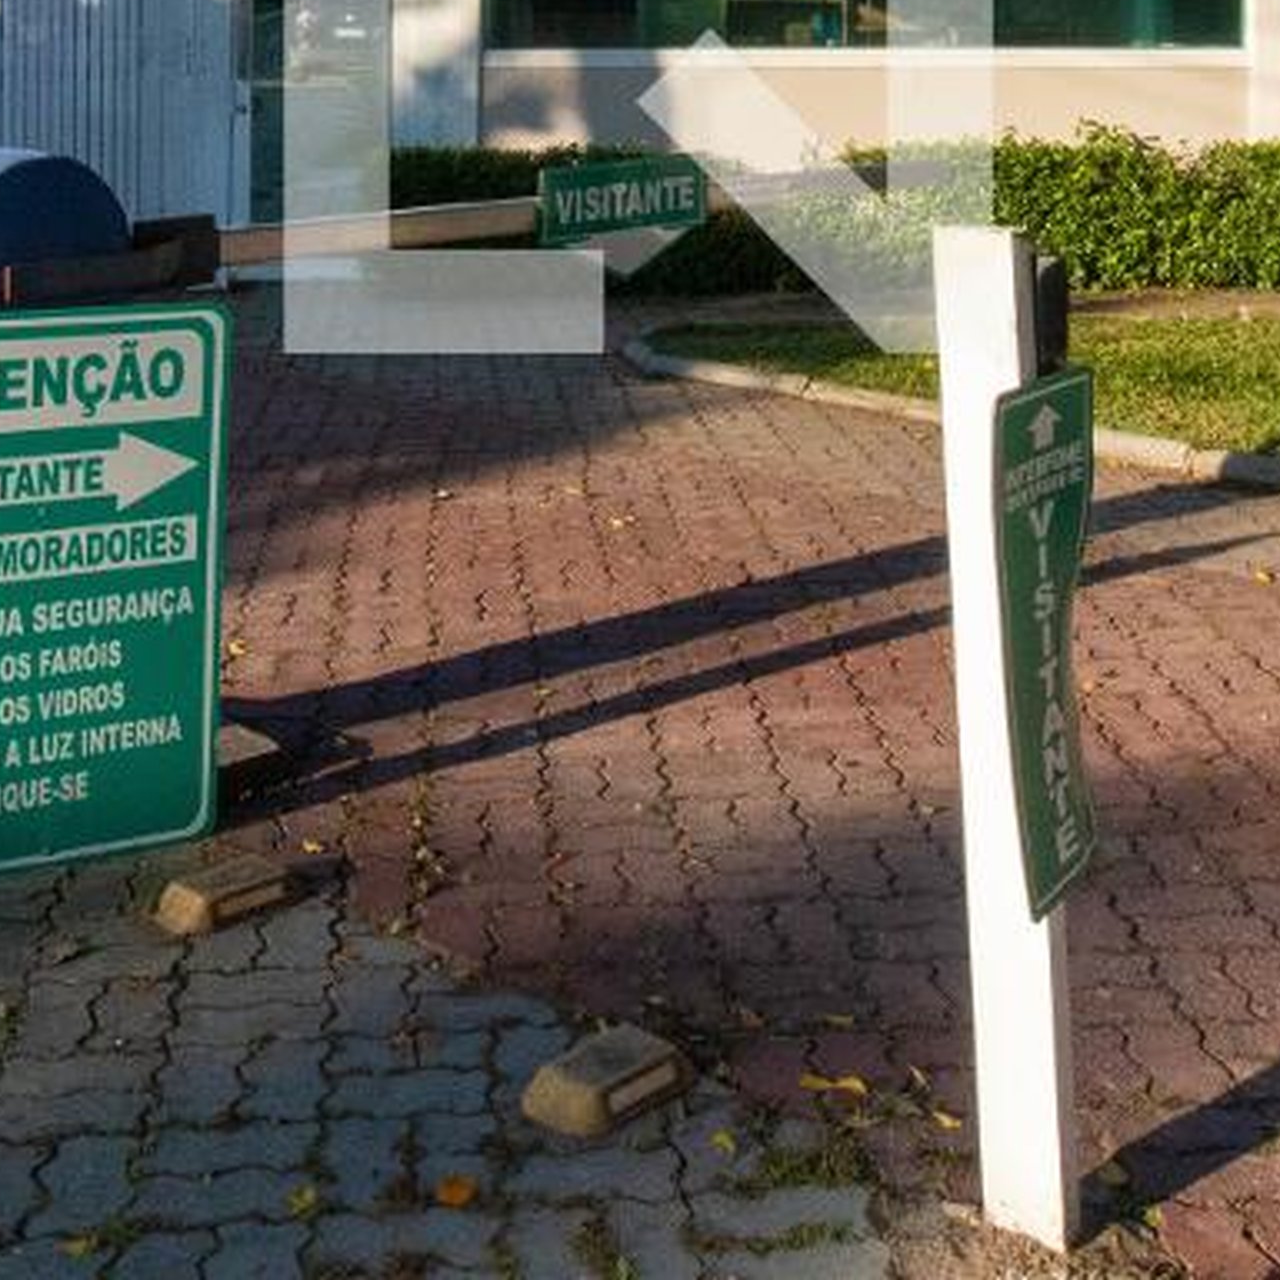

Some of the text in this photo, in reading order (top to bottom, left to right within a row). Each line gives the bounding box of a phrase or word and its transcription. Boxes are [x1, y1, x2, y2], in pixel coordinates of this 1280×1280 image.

[555, 175, 695, 224] VISITANTE
[32, 585, 195, 634] SEGURANÇA
[0, 651, 32, 682] OS
[38, 637, 122, 678] FARÓIS
[1028, 499, 1081, 865] VISITANTE
[37, 681, 126, 721] VIDROS
[4, 738, 22, 769] A
[28, 729, 76, 765] LUZ
[80, 713, 183, 758] INTERNA
